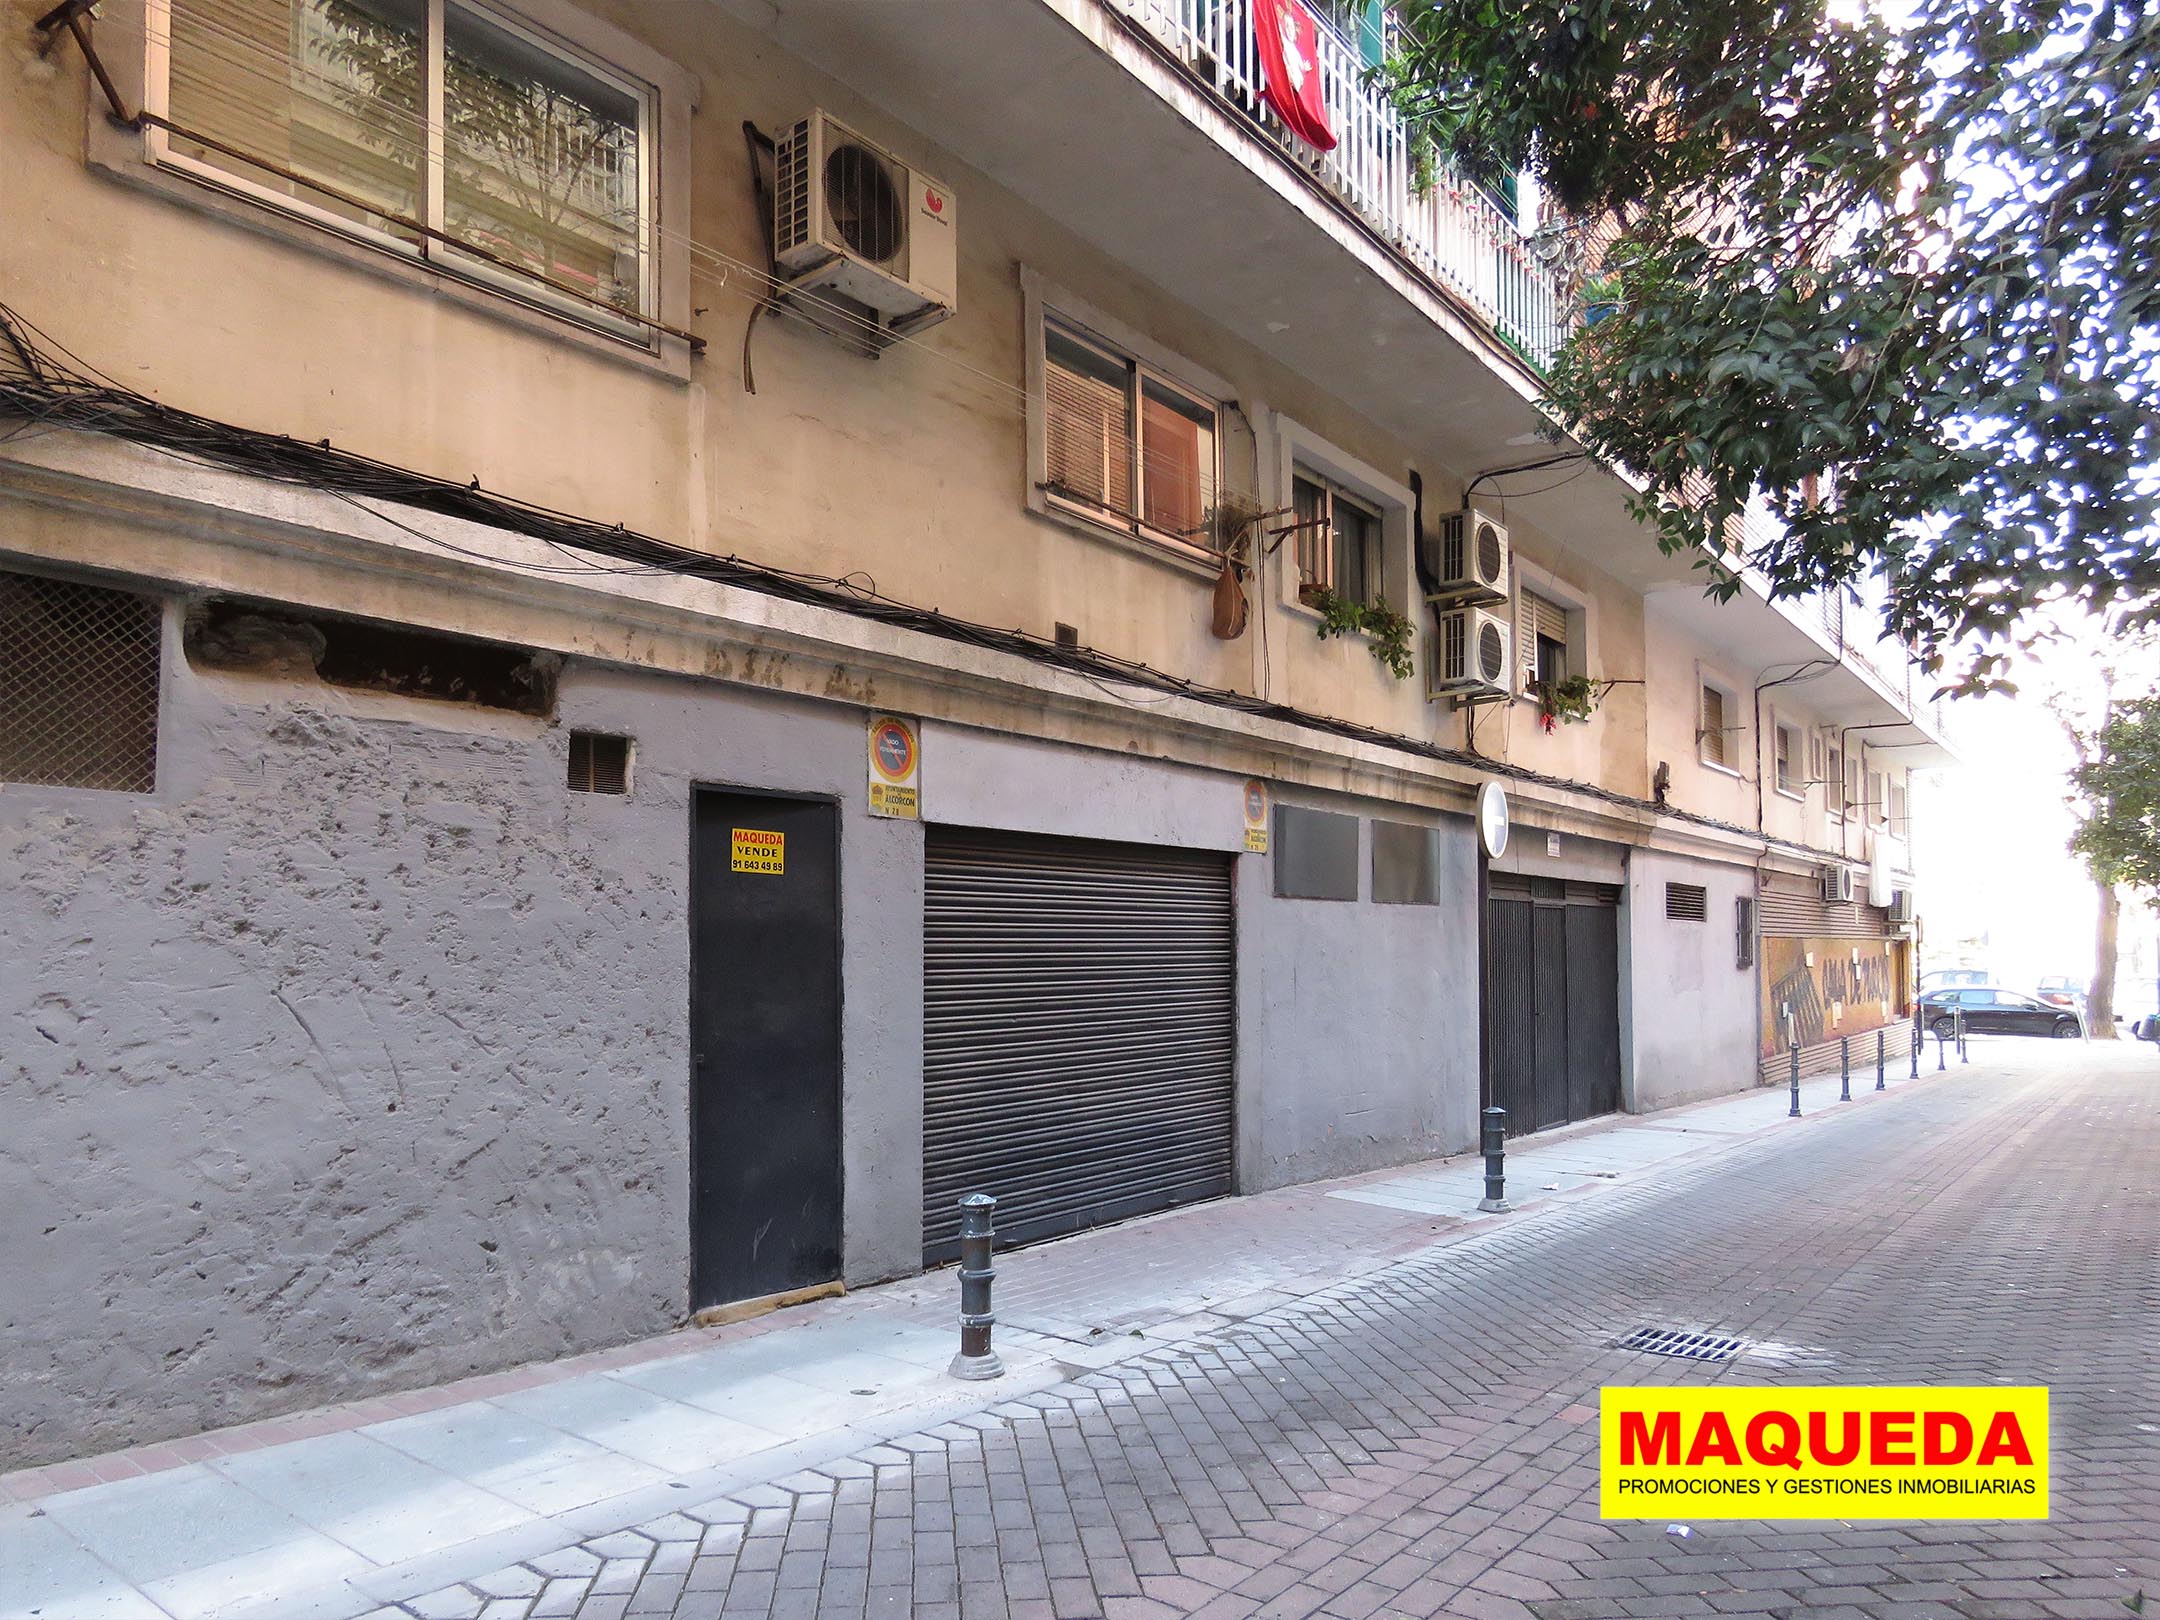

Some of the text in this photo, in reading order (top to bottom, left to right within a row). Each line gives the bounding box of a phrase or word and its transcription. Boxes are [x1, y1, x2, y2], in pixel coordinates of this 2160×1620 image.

[734, 831, 783, 846] MAQUEDA
[737, 846, 778, 858] VENDE
[732, 859, 783, 872] 91 643 49 89
